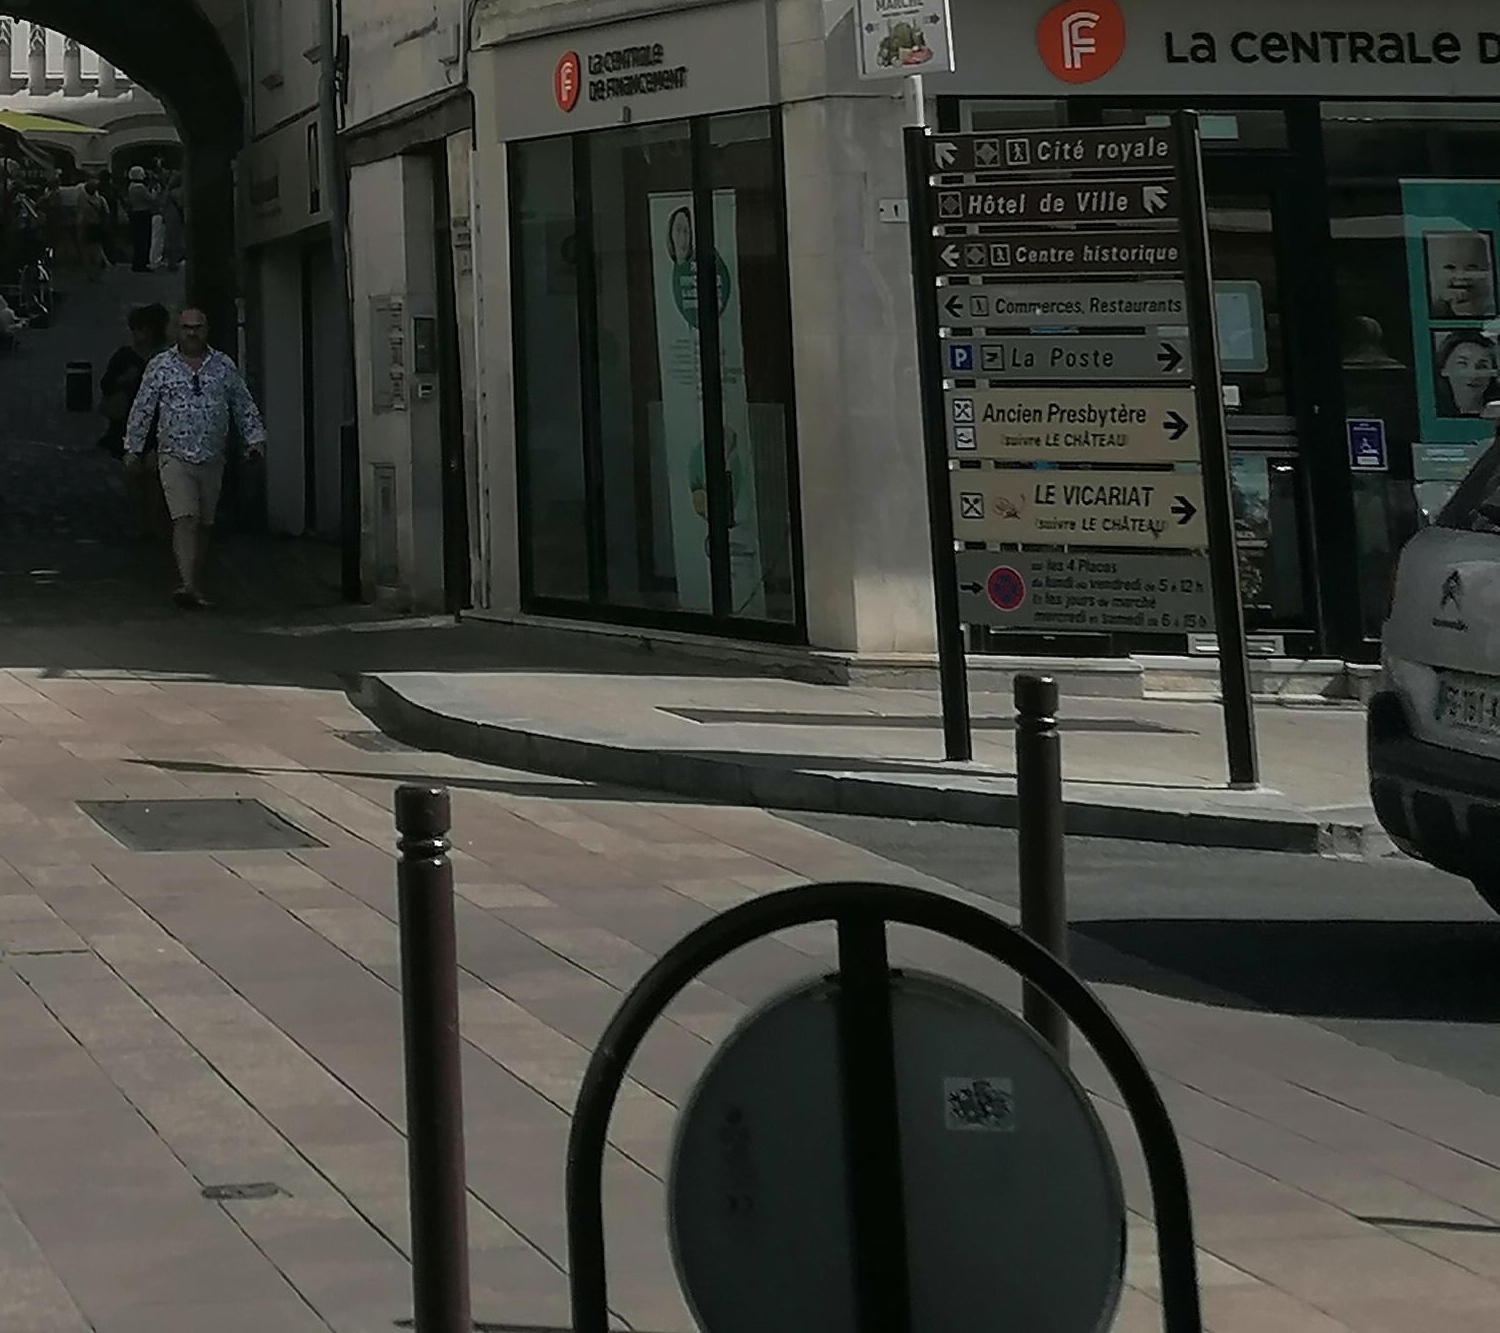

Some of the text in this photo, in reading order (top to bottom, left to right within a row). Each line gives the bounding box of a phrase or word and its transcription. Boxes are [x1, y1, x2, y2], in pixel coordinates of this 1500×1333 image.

[1037, 136, 1168, 163] Cité royale
[969, 191, 1128, 214] Hôtel de Ville
[1015, 244, 1178, 264] Centre historique
[1090, 297, 1182, 314] Restaurants
[955, 348, 1114, 367] P La Poste
[982, 404, 1147, 428] Ancien Presbytère
[1045, 434, 1060, 447] LE
[1034, 484, 1154, 507] LE VICARIAT
[1082, 517, 1098, 531] LE
[1159, 578, 1168, 592] 5
